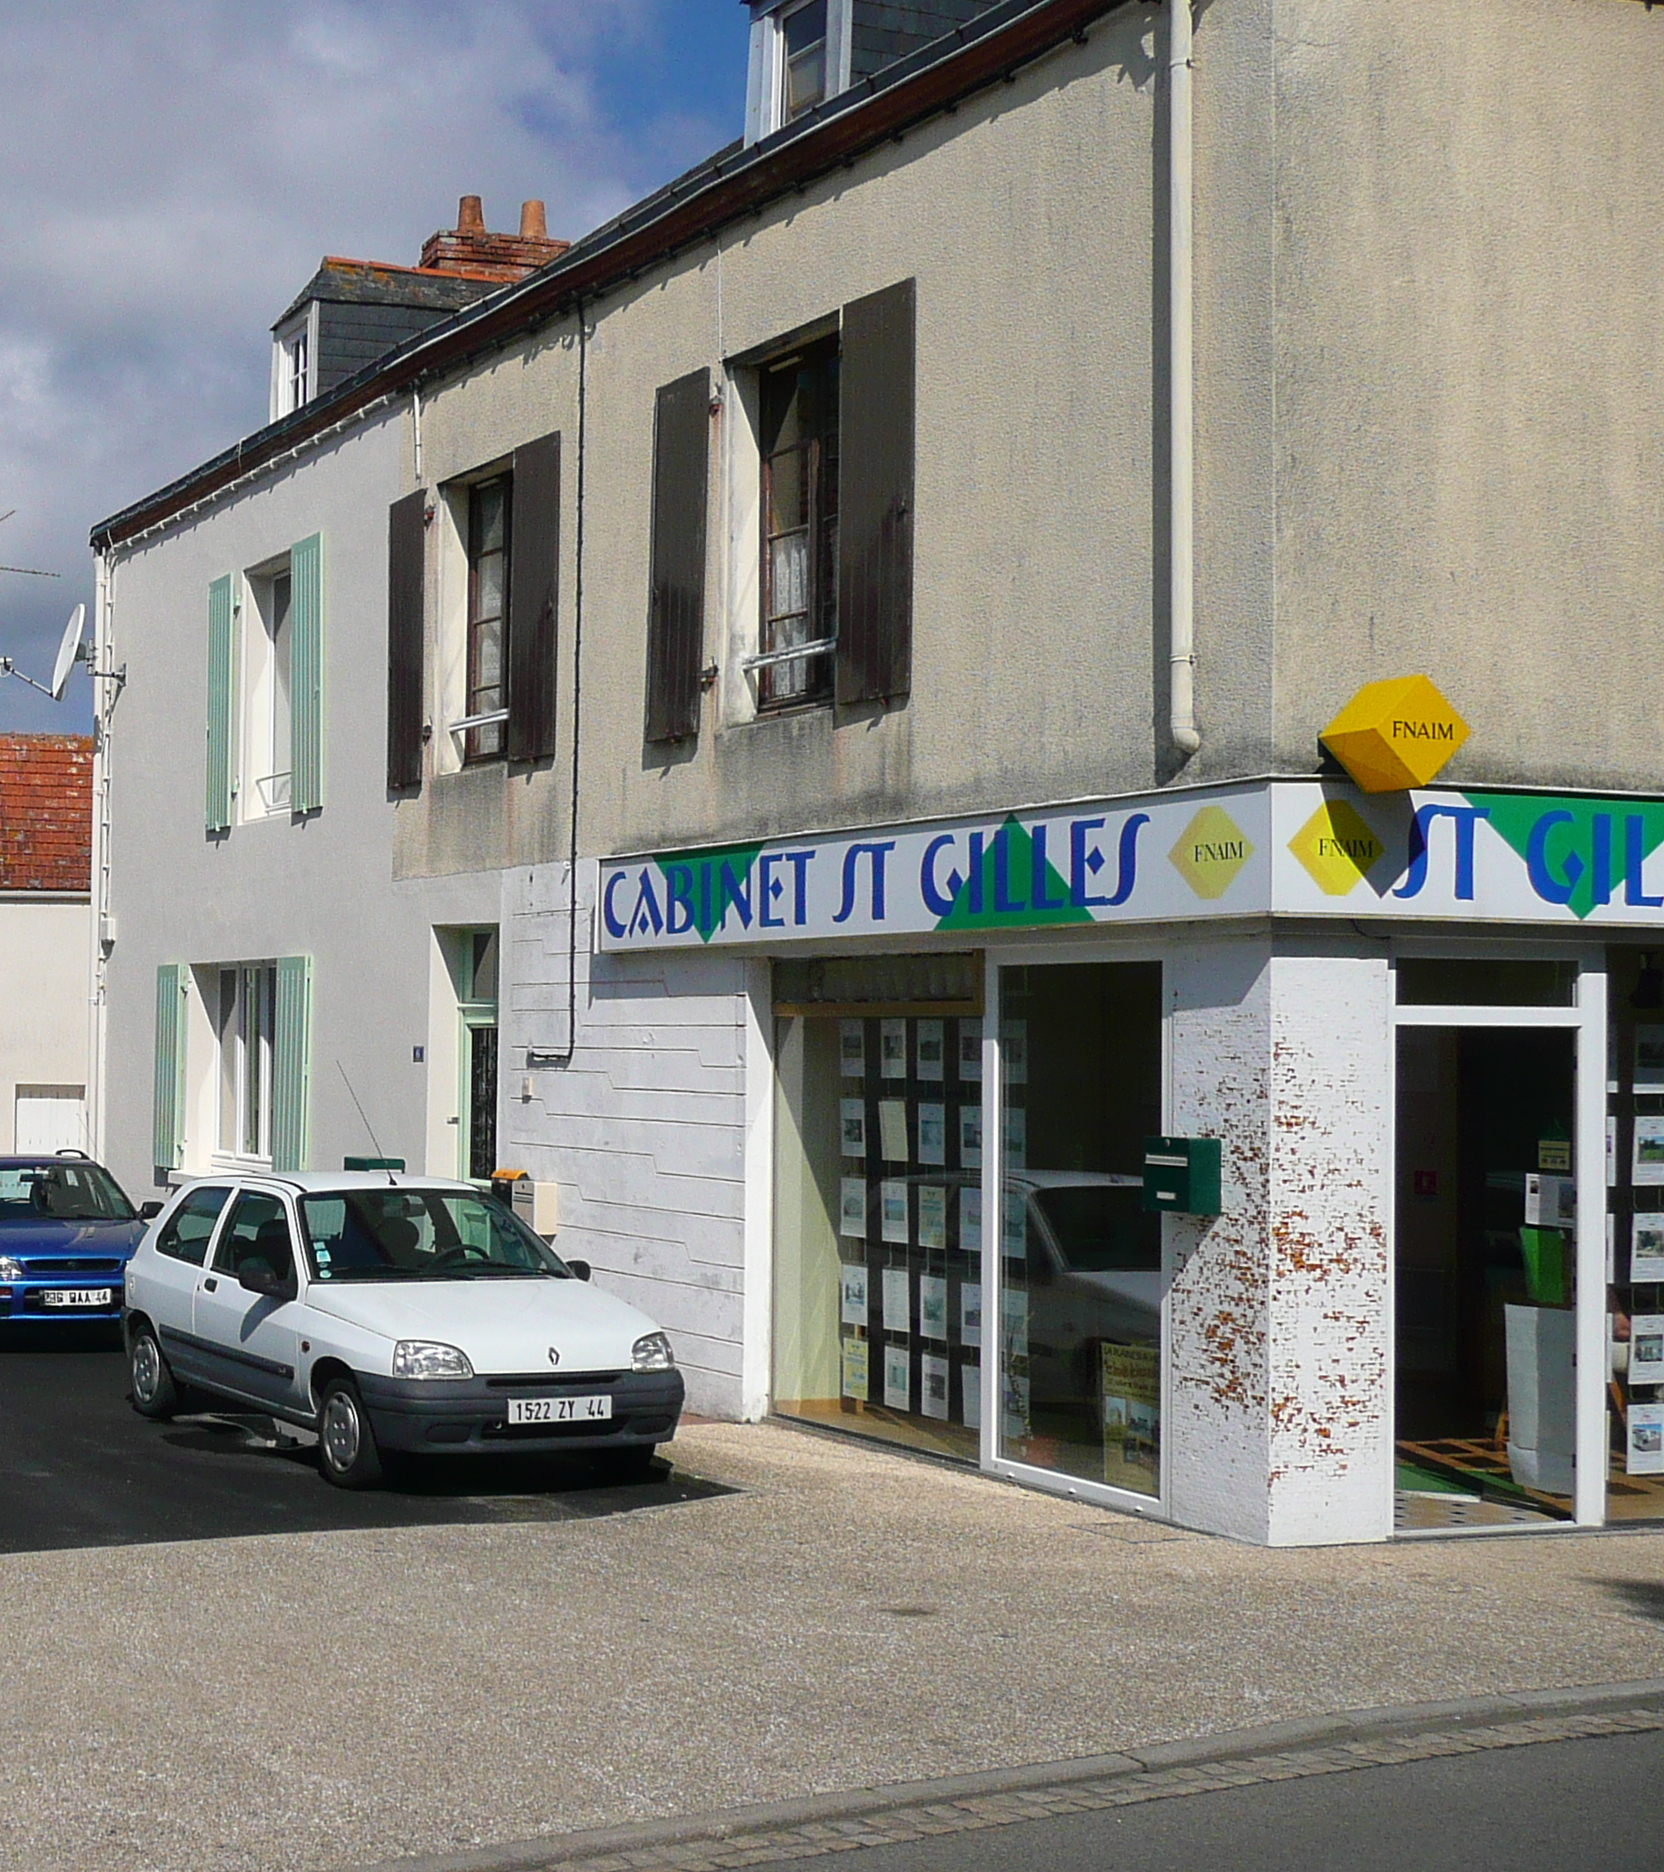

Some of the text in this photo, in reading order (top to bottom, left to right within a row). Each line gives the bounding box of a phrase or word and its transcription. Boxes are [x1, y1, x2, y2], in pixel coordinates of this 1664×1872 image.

[1392, 720, 1454, 741] FNAIM
[1193, 840, 1245, 863] FNAIM
[1318, 837, 1375, 859] FNAIM
[1391, 803, 1664, 907] ST GIL
[603, 812, 1151, 939] CABINET ST GILLES
[516, 1398, 604, 1421] 1522 ZY 44
